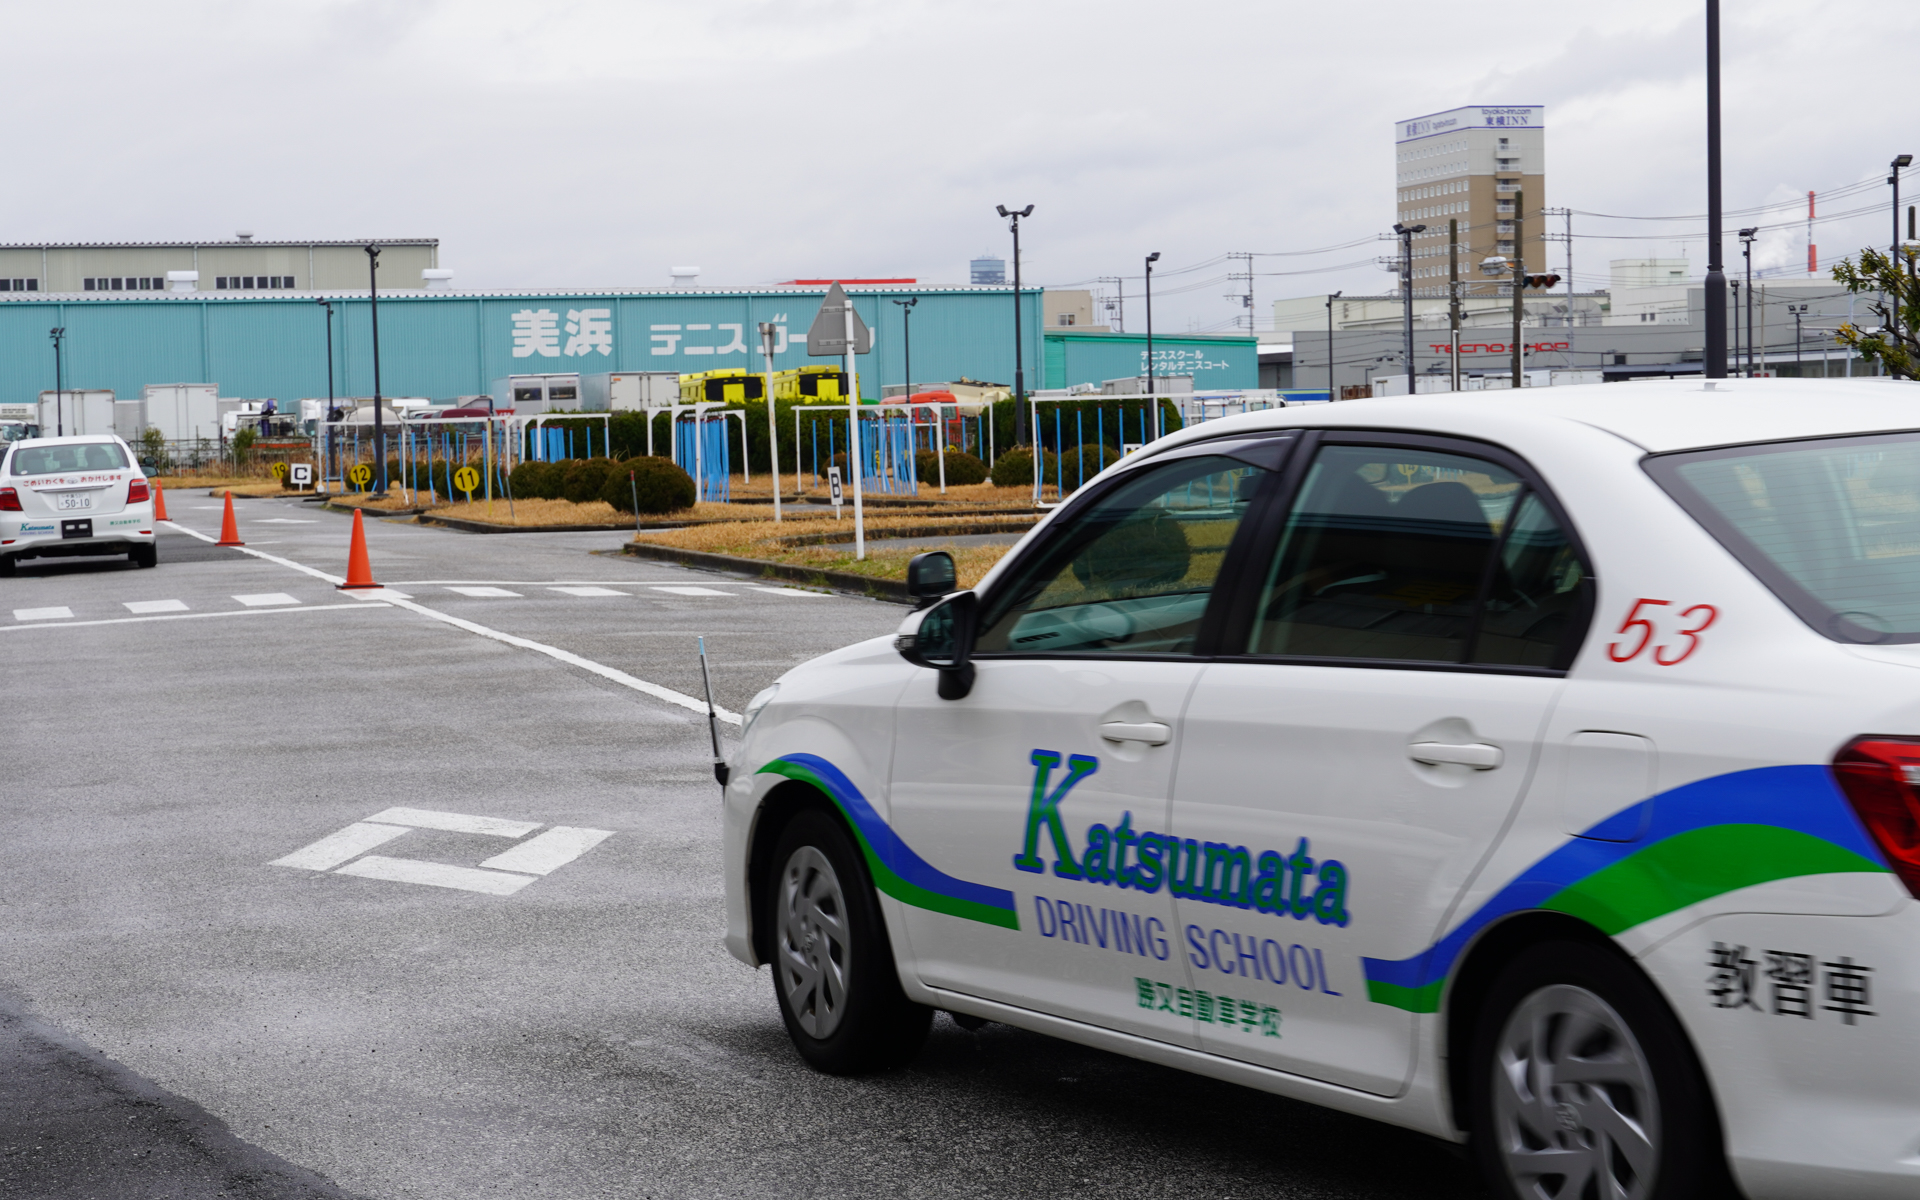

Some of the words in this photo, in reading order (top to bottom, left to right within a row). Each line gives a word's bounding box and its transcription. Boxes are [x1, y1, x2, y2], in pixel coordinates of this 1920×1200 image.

[1485, 116, 1528, 126] 東横INN
[511, 308, 612, 358] 美浜
[1140, 350, 1204, 360] テニススクール
[273, 464, 286, 477] 19
[294, 467, 308, 480] C
[352, 467, 369, 482] 12
[457, 470, 475, 488] 11
[830, 473, 841, 498] B
[1605, 597, 1720, 666] 53
[1013, 748, 1351, 928] Katsumata
[1034, 895, 1170, 962] DRIVING
[1185, 923, 1344, 998] SCHOOL
[1706, 941, 1877, 1027] 教習車
